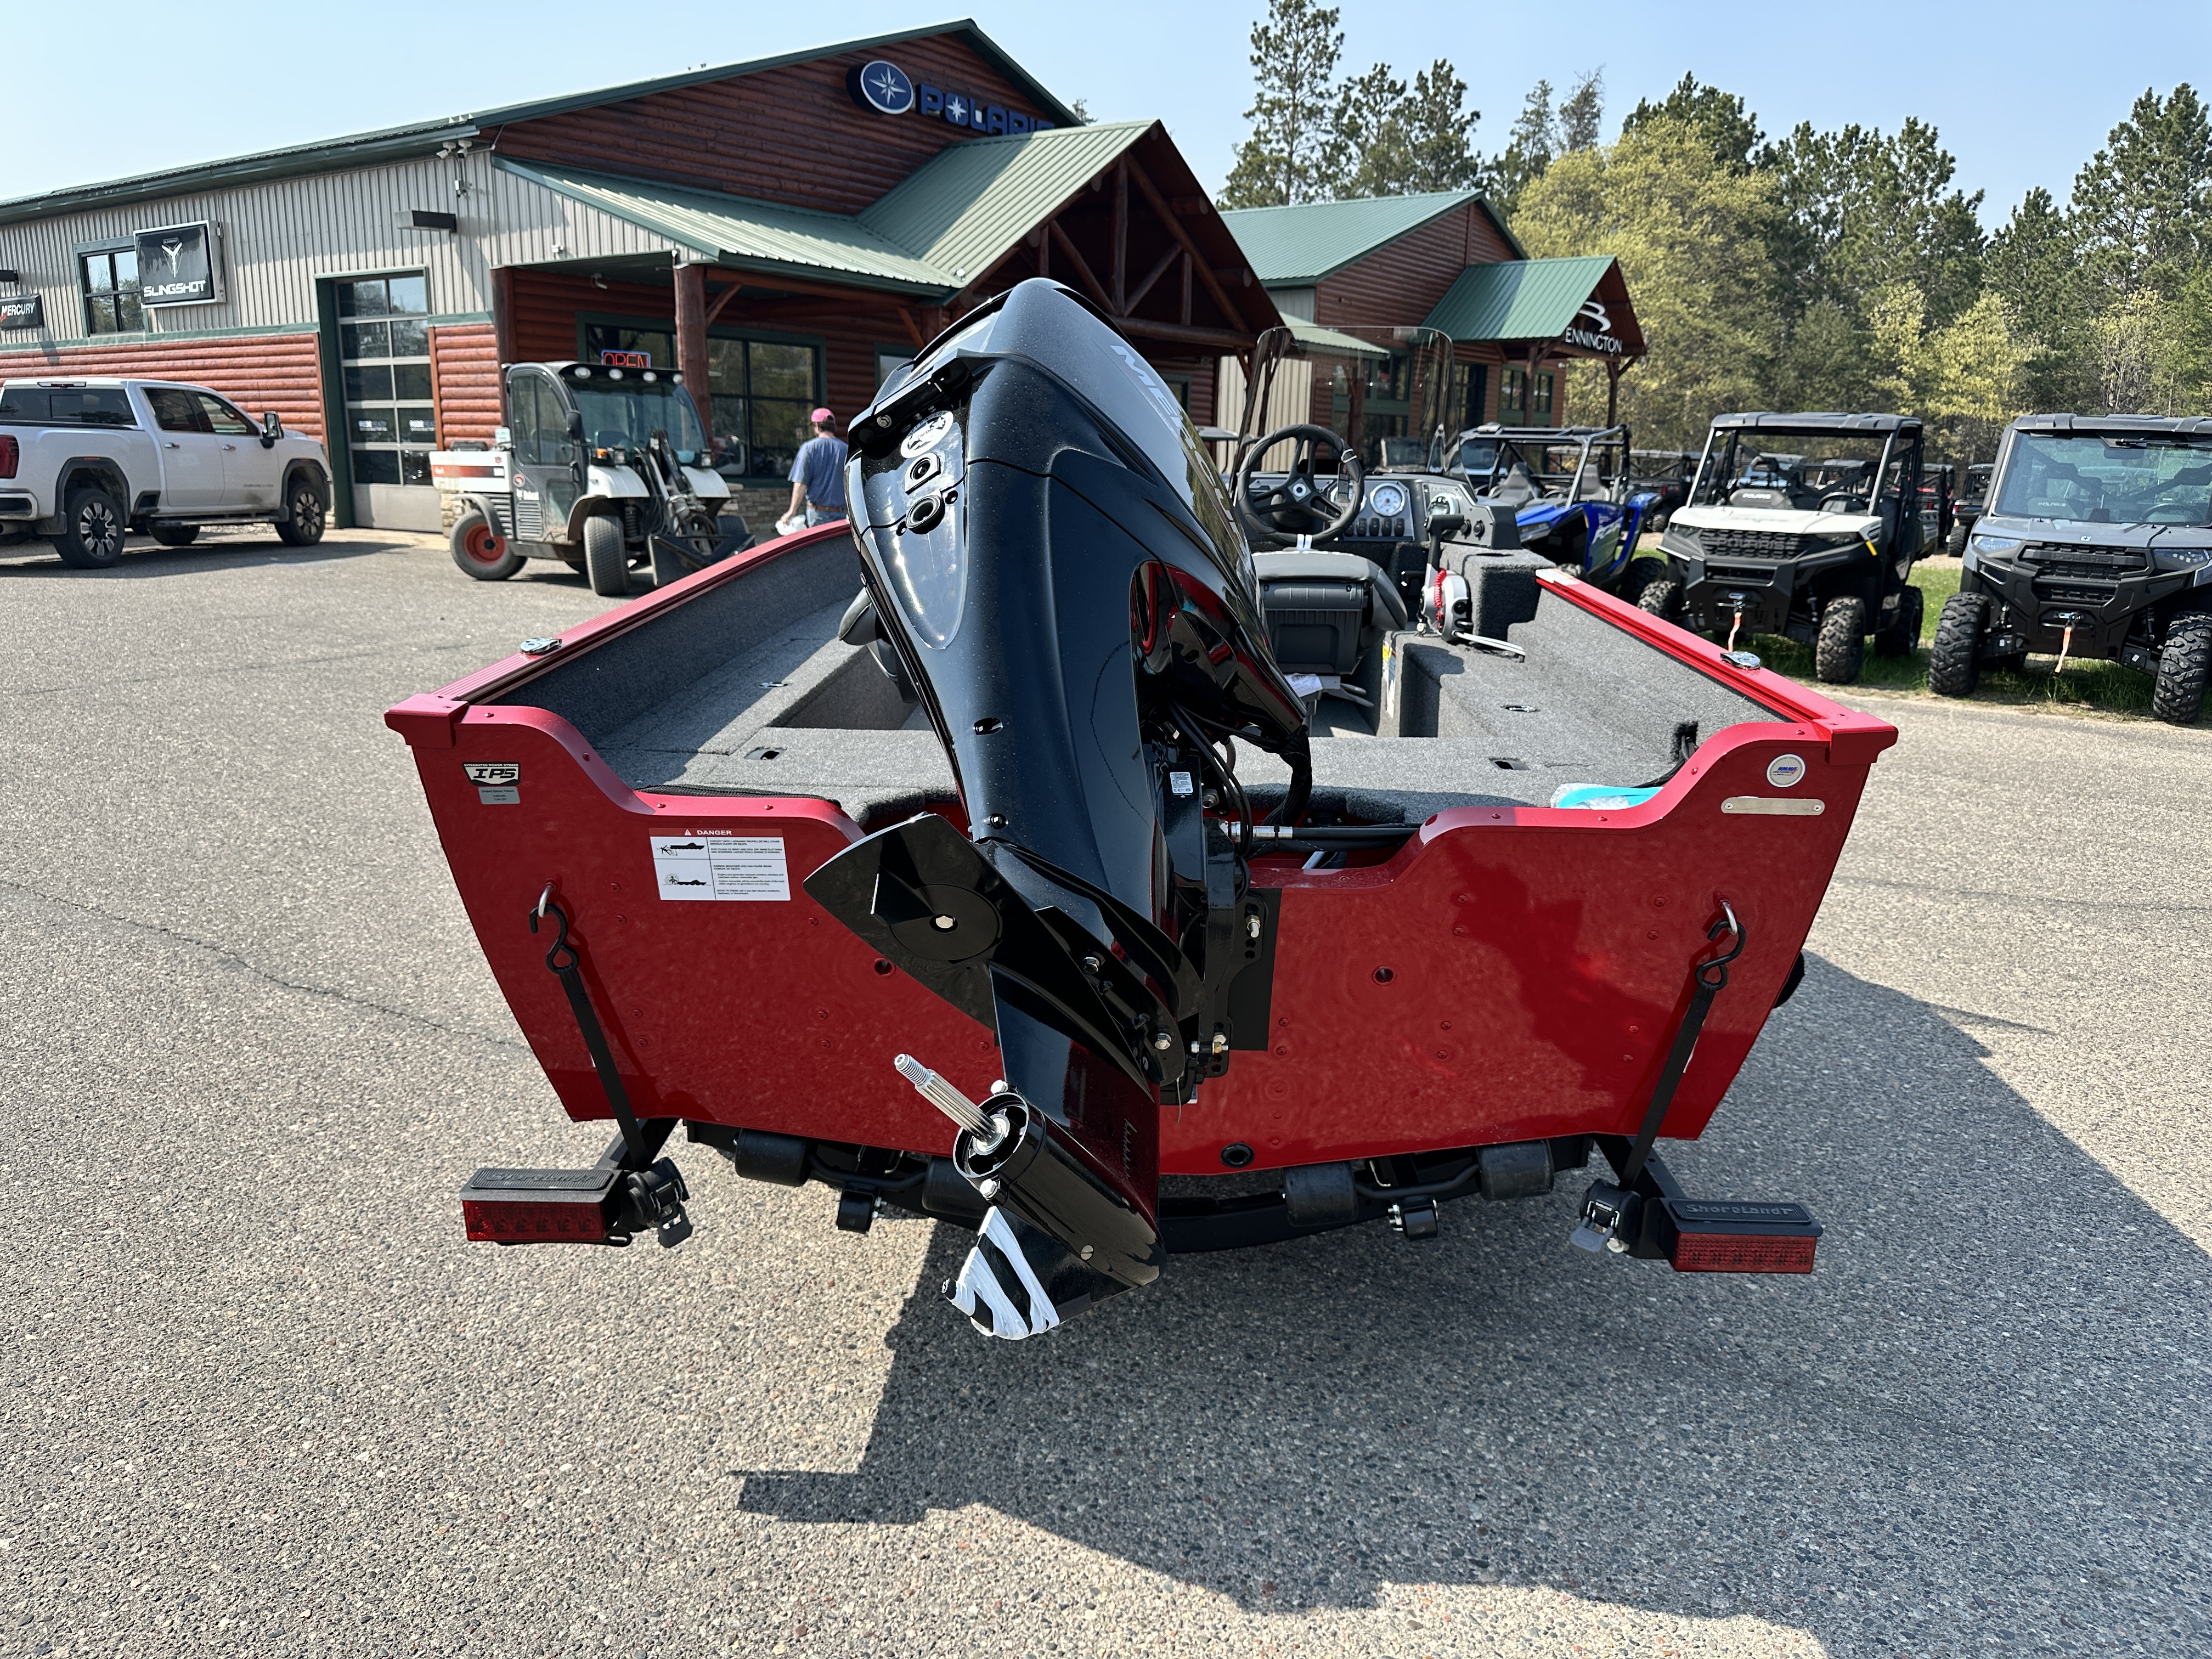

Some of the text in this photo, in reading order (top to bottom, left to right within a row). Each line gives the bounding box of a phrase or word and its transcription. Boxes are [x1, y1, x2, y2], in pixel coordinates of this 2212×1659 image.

[143, 280, 206, 297] SLINGSHOT
[1, 302, 35, 317] MERCURY
[1565, 326, 1622, 353] ENNINGTON
[603, 353, 648, 368] OPEN
[1717, 537, 1785, 550] POLARIS
[2053, 552, 2112, 564] POLARIS
